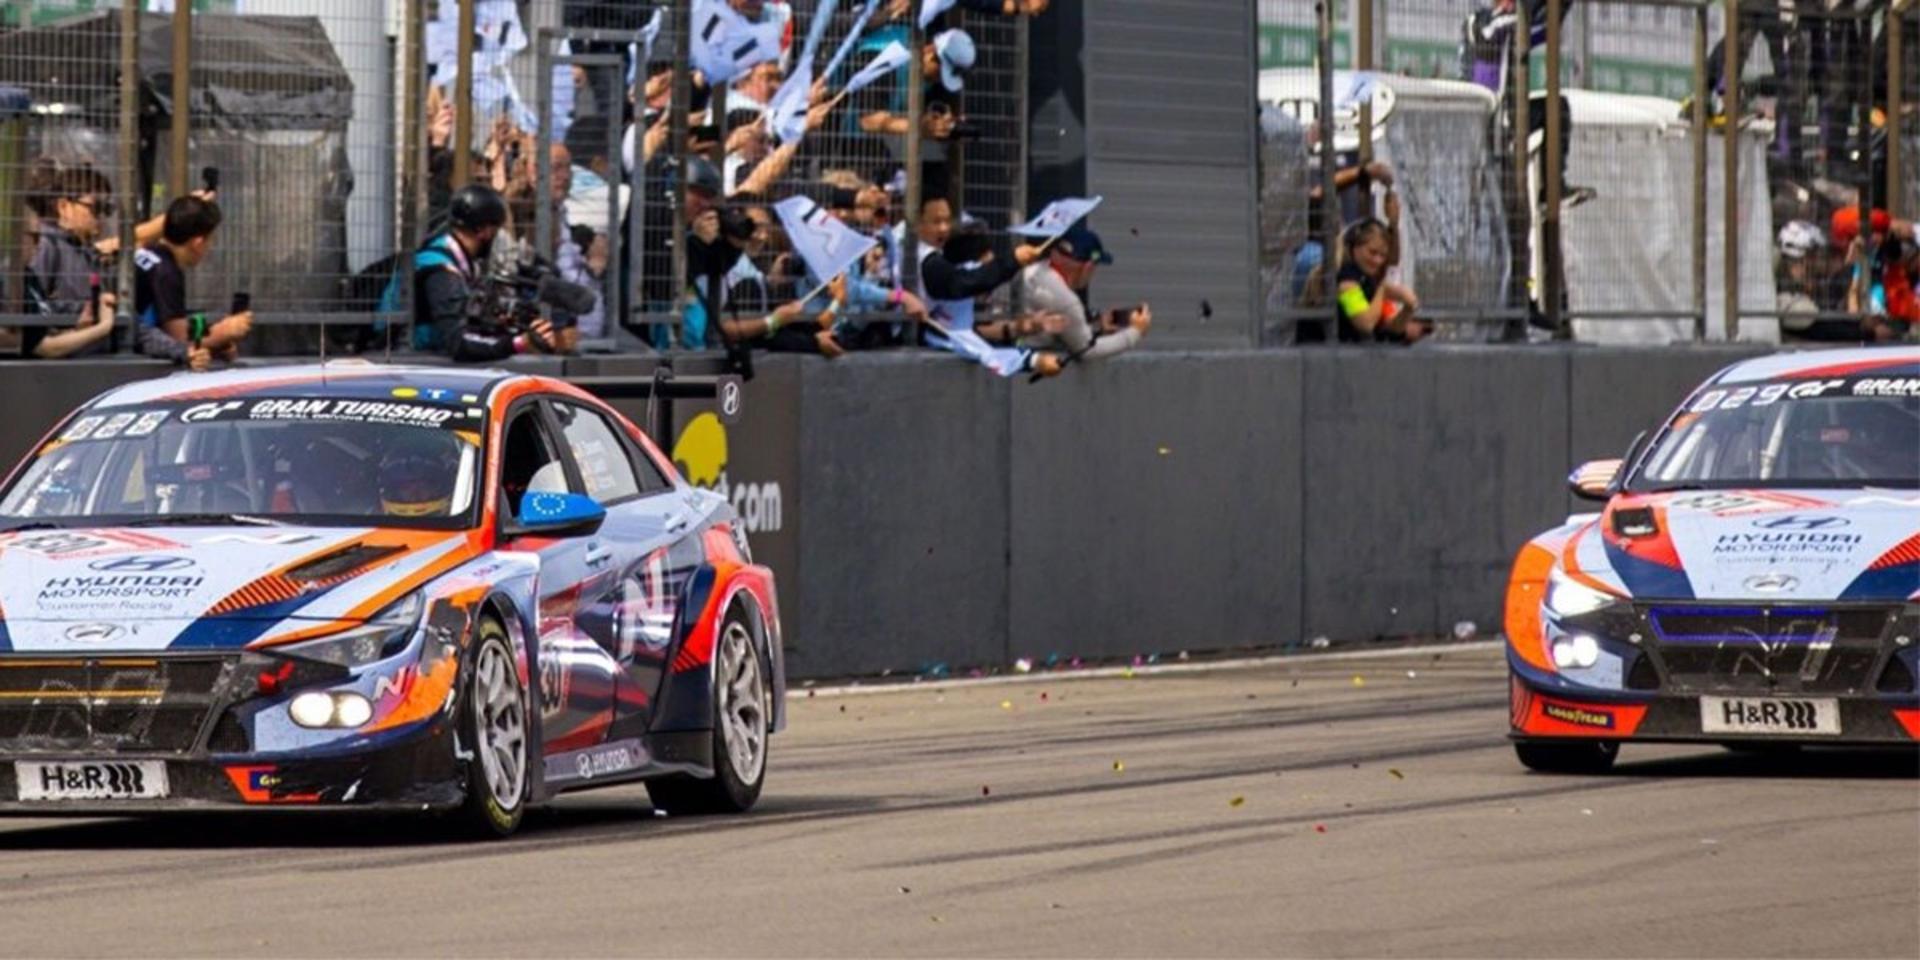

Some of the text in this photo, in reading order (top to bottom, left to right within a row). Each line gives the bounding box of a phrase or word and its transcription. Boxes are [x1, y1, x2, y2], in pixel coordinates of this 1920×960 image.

[1691, 384, 1790, 412] 029
[250, 400, 453, 423] GRAN TURISMO
[366, 416, 442, 428] SIMULATOR
[1718, 533, 1862, 543] HYUNDAI
[1713, 543, 1854, 553] MOTORSPORT
[45, 575, 204, 588] HYUNDAI
[38, 587, 195, 599] MOTORSPORT
[1722, 701, 1780, 724] H&R
[40, 765, 103, 791] H&R
